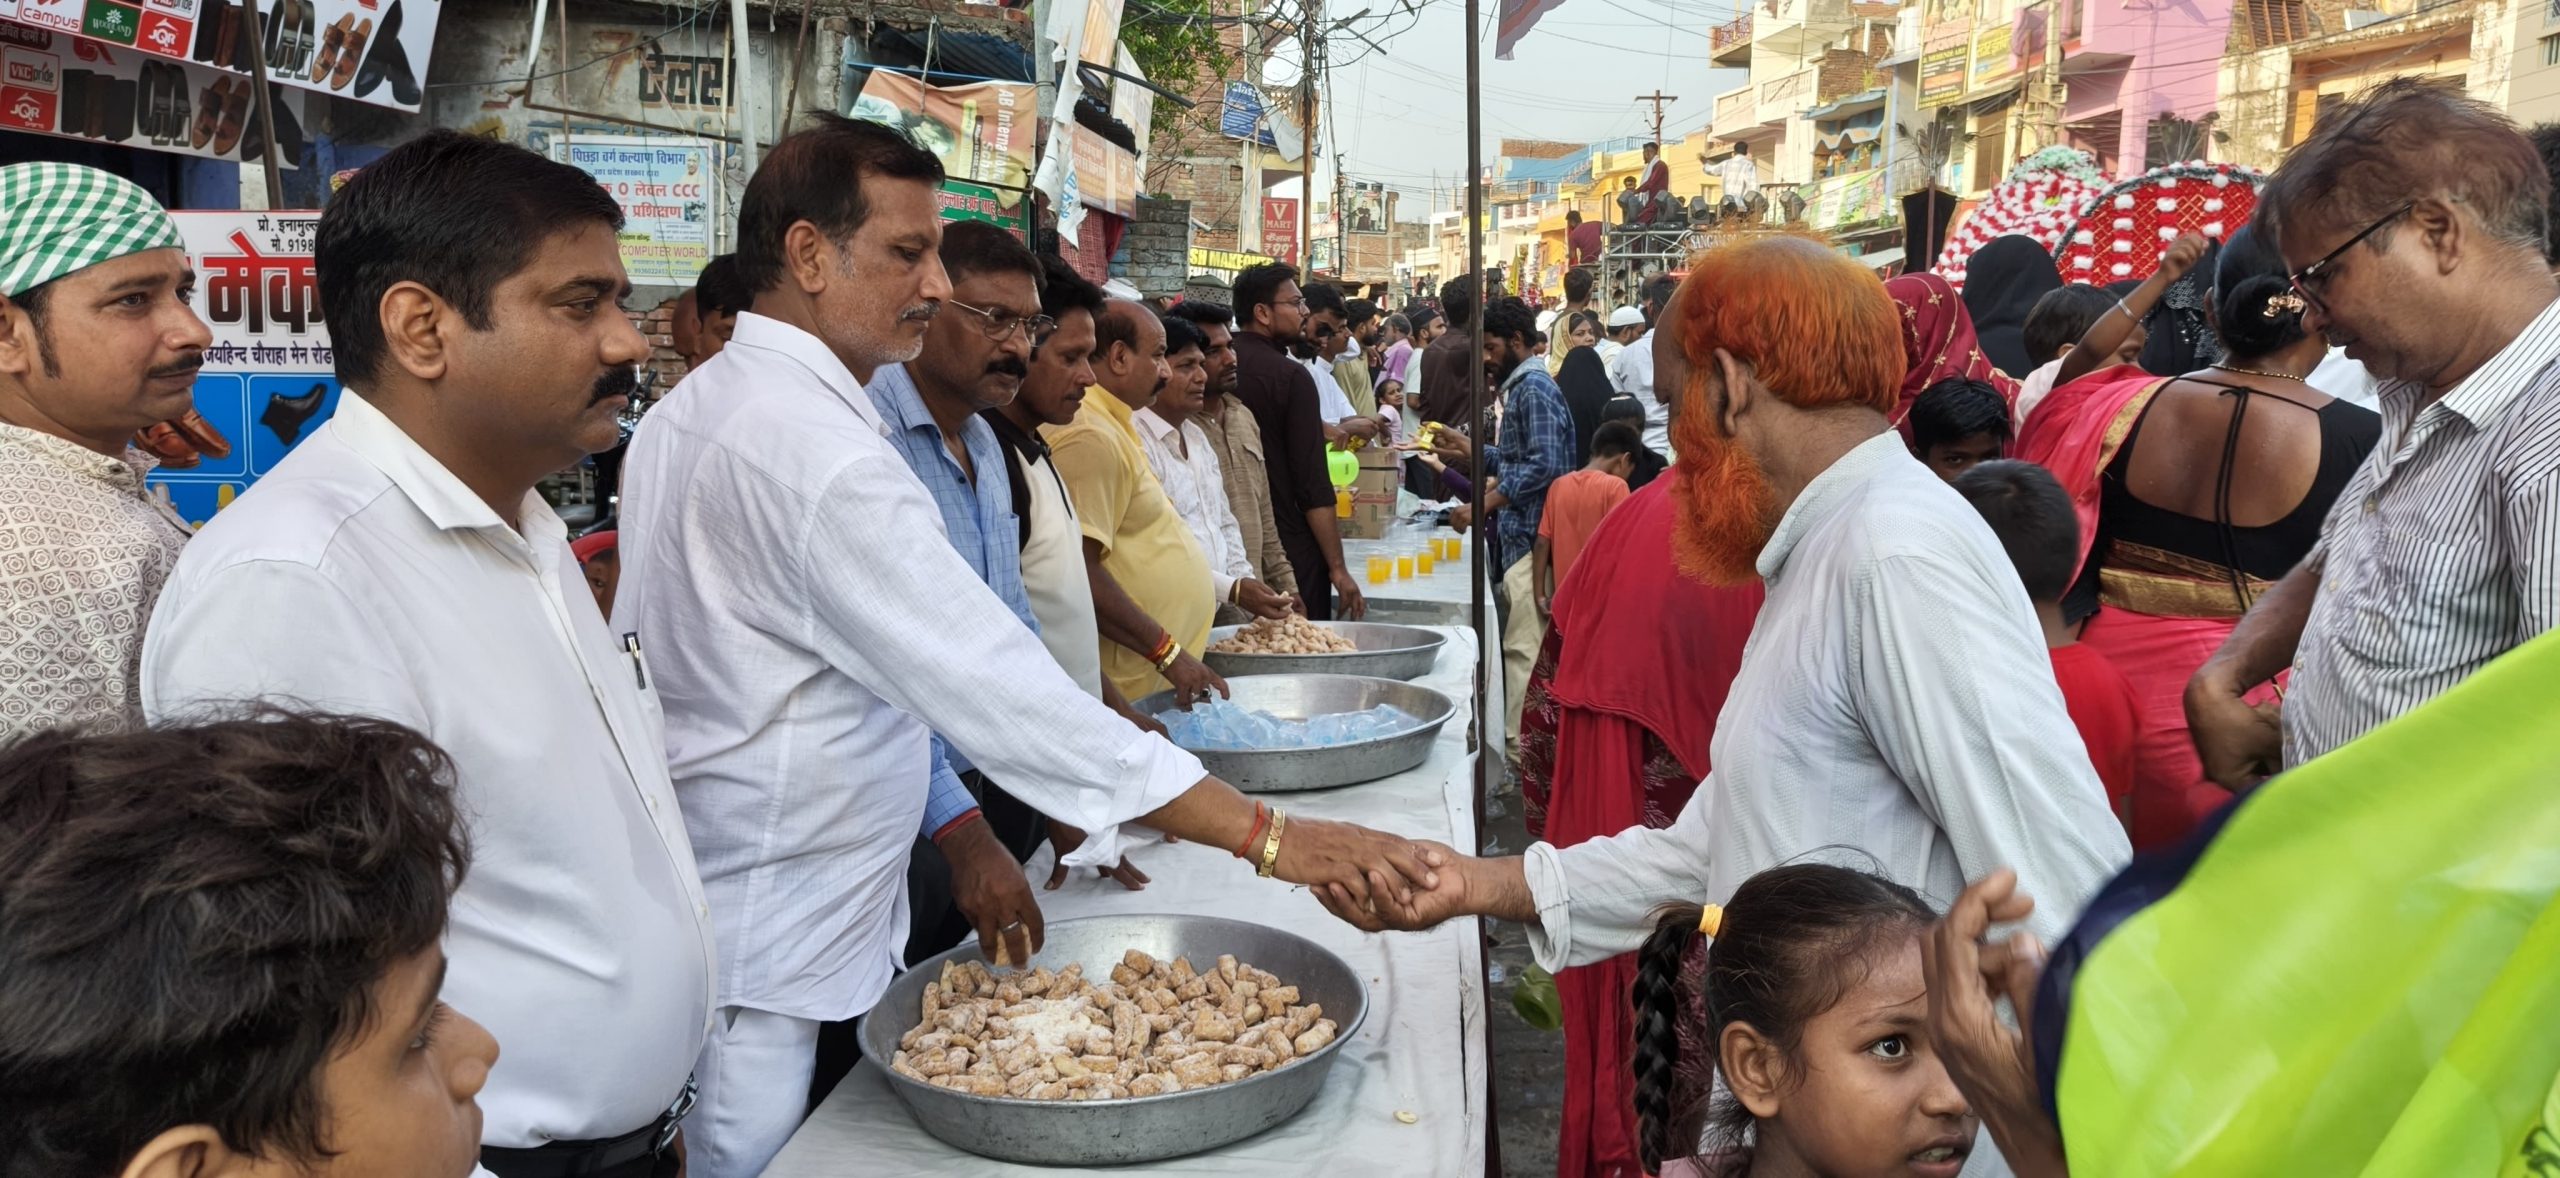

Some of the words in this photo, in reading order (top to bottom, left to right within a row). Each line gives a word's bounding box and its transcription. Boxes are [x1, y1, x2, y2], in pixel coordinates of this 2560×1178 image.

[23, 7, 80, 30] campus
[148, 28, 176, 47] JQR
[11, 64, 32, 80] VKC
[998, 88, 1015, 107] AB
[10, 103, 40, 121] JQR
[572, 147, 600, 166] पिछड़ा
[602, 148, 618, 163] वर्ग
[619, 151, 654, 164] कल्याण
[656, 149, 686, 165] विभाग
[635, 179, 667, 197] लेवल
[672, 183, 701, 198] CCC
[1271, 203, 1288, 220] V
[257, 214, 274, 232] प्रो.
[1266, 220, 1292, 229] MART
[270, 234, 285, 252] मो.
[621, 244, 671, 257] COMPUTER
[673, 246, 707, 259] WORLD
[204, 340, 248, 365] जयहिन्द
[251, 340, 288, 366] चौराहा
[290, 340, 309, 364] मेन
